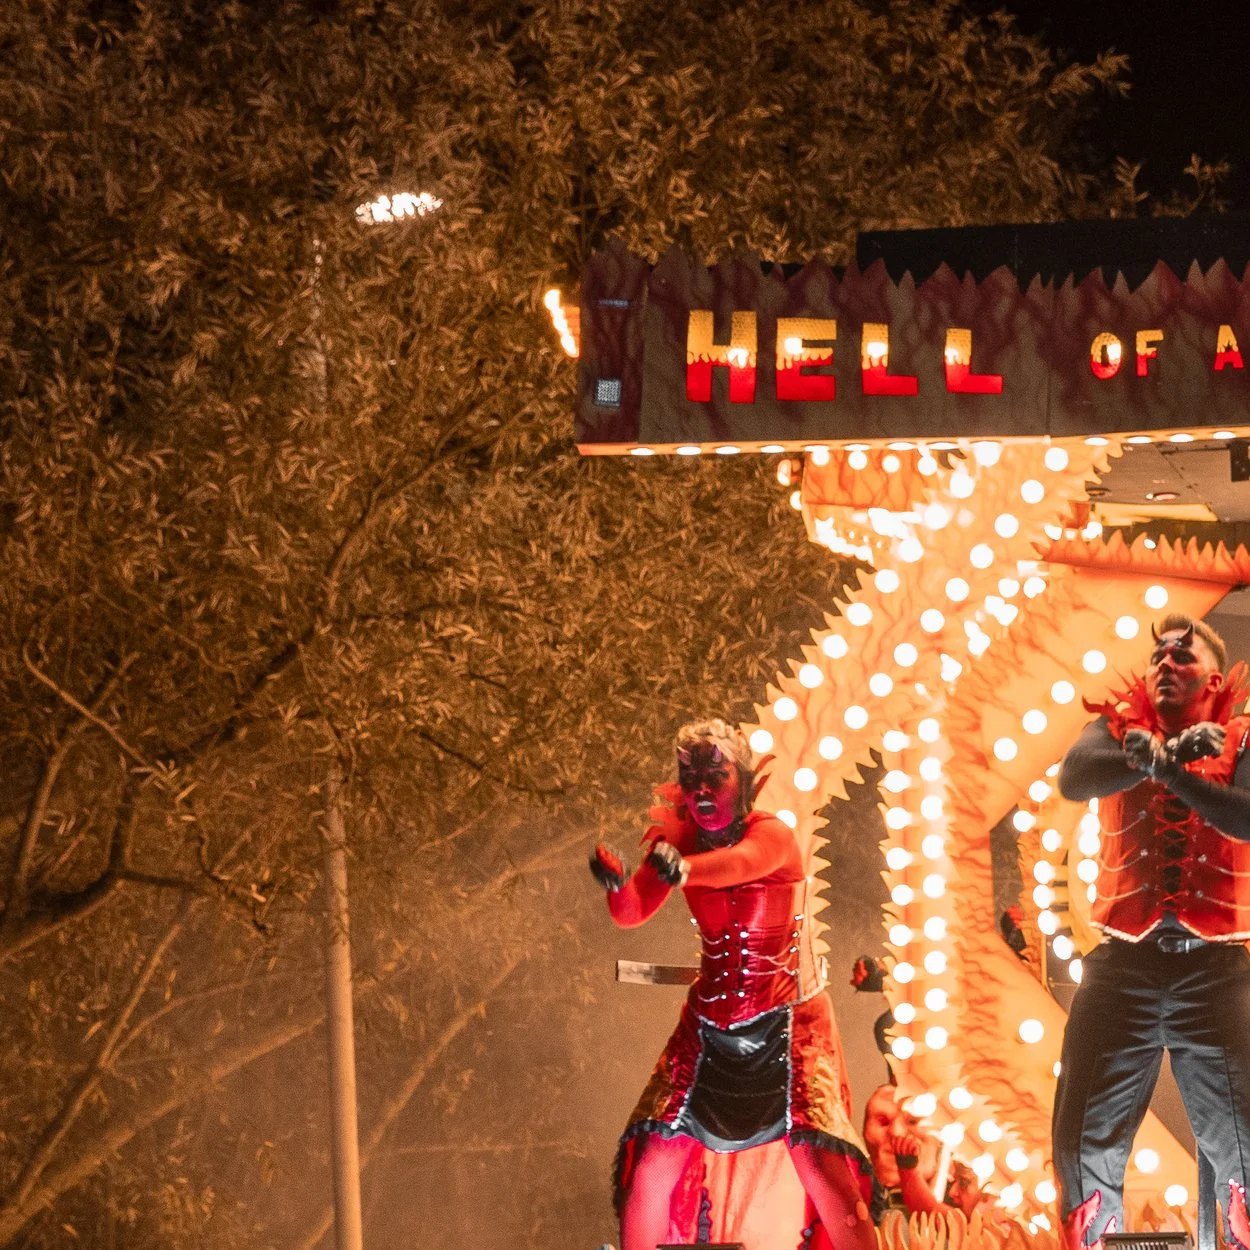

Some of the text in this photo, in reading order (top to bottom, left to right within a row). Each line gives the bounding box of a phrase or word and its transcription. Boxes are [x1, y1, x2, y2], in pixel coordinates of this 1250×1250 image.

[686, 310, 1003, 403] HELL
[1090, 329, 1164, 379] OF
[1213, 324, 1244, 371] A
